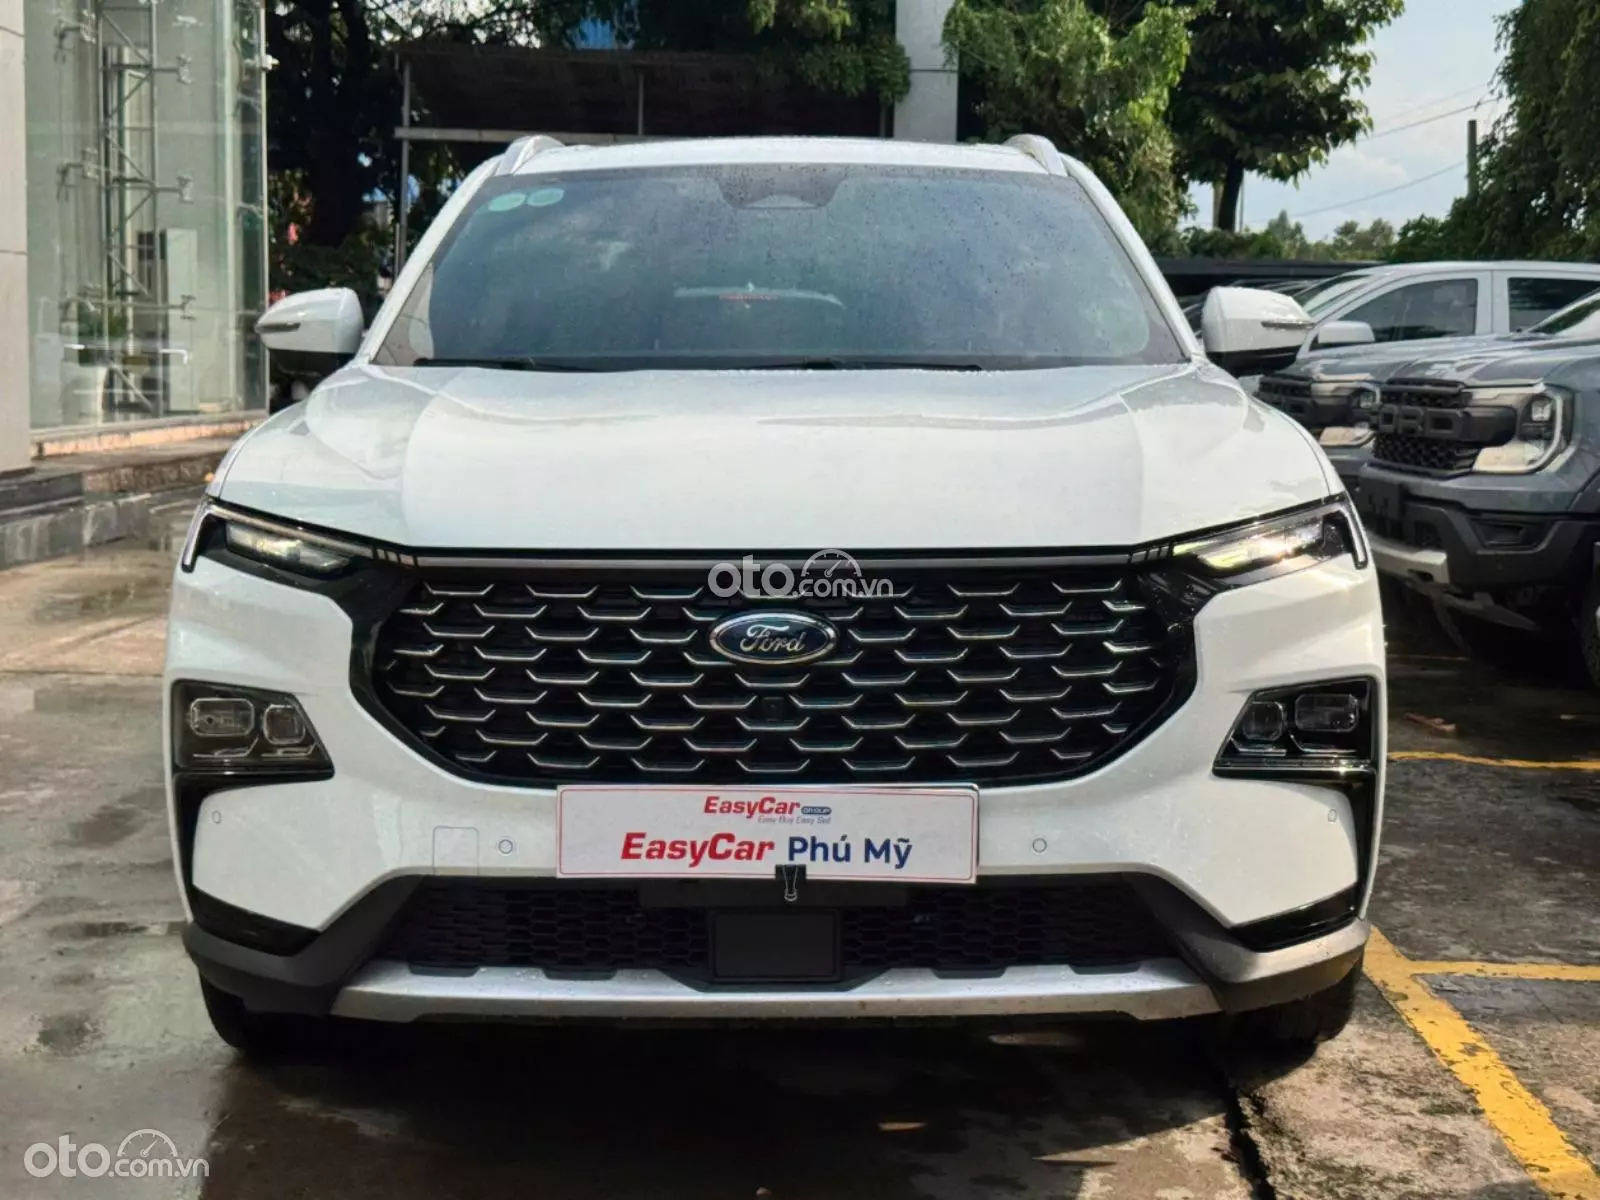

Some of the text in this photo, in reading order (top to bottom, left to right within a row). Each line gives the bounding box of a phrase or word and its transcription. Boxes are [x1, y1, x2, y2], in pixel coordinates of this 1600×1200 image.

[739, 623, 807, 652] Ford
[703, 795, 801, 819] EasyCar
[620, 831, 913, 869] EasyCar Phú Mỹ
